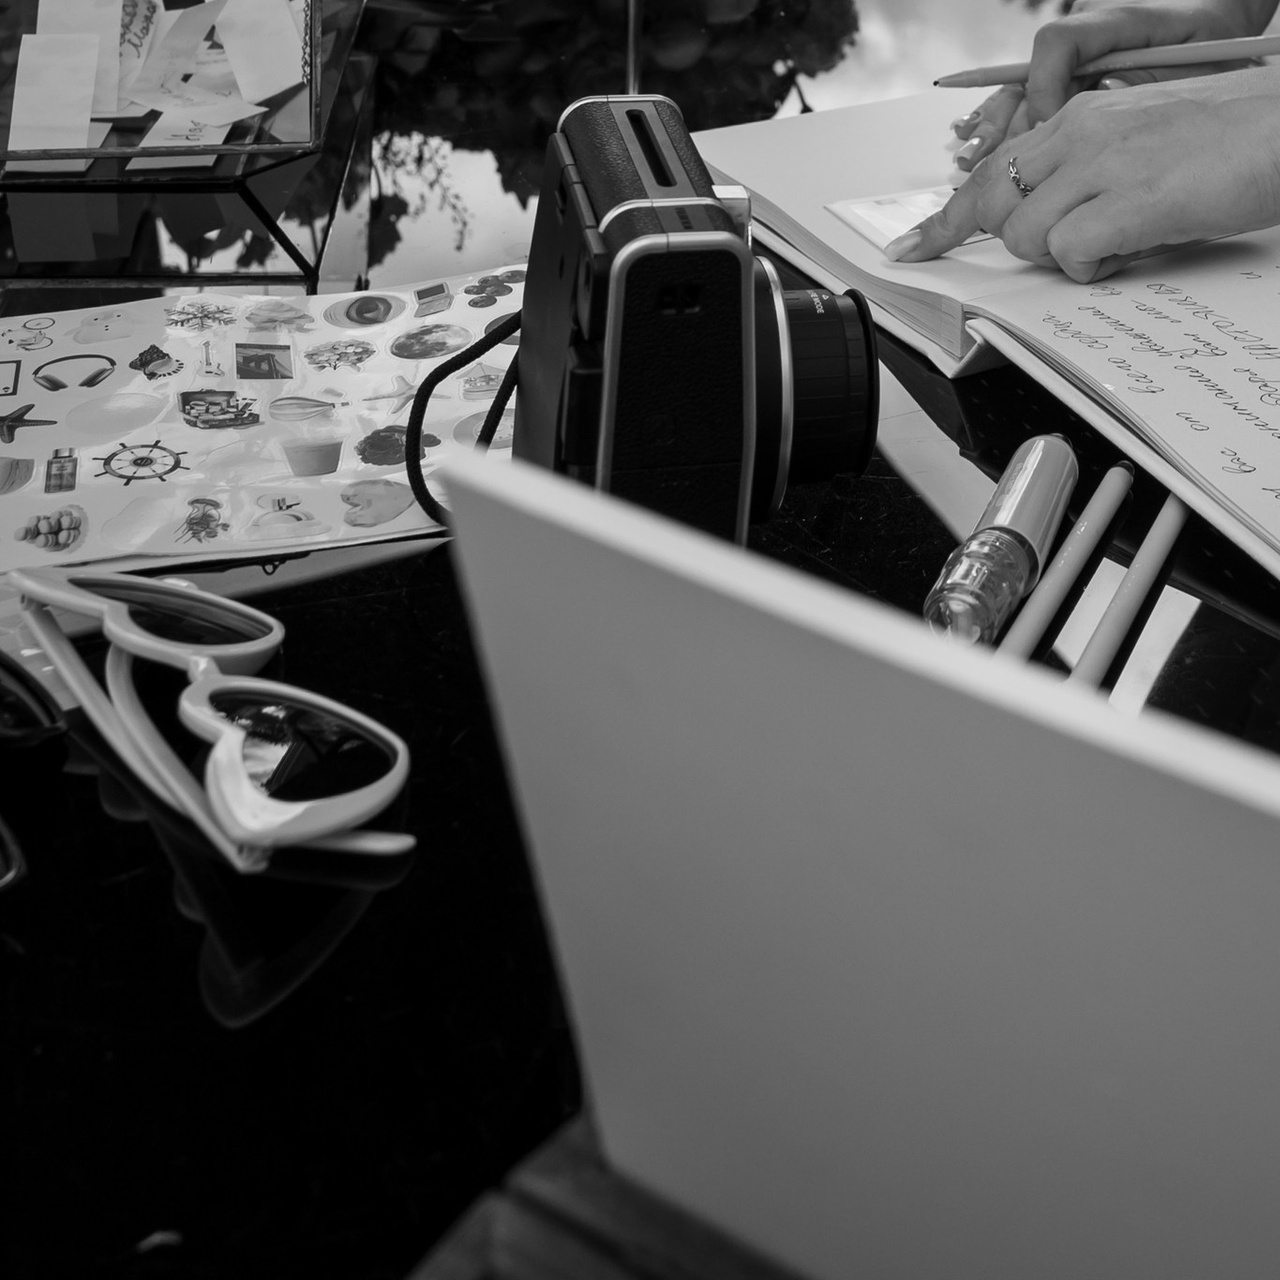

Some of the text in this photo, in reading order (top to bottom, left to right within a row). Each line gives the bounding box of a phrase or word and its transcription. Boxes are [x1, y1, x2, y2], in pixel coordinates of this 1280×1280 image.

[1130, 298, 1182, 323] мы
[1182, 332, 1228, 357] вам
[1107, 356, 1165, 393] всего
[1175, 411, 1210, 431] от
[1219, 446, 1256, 474] вас
